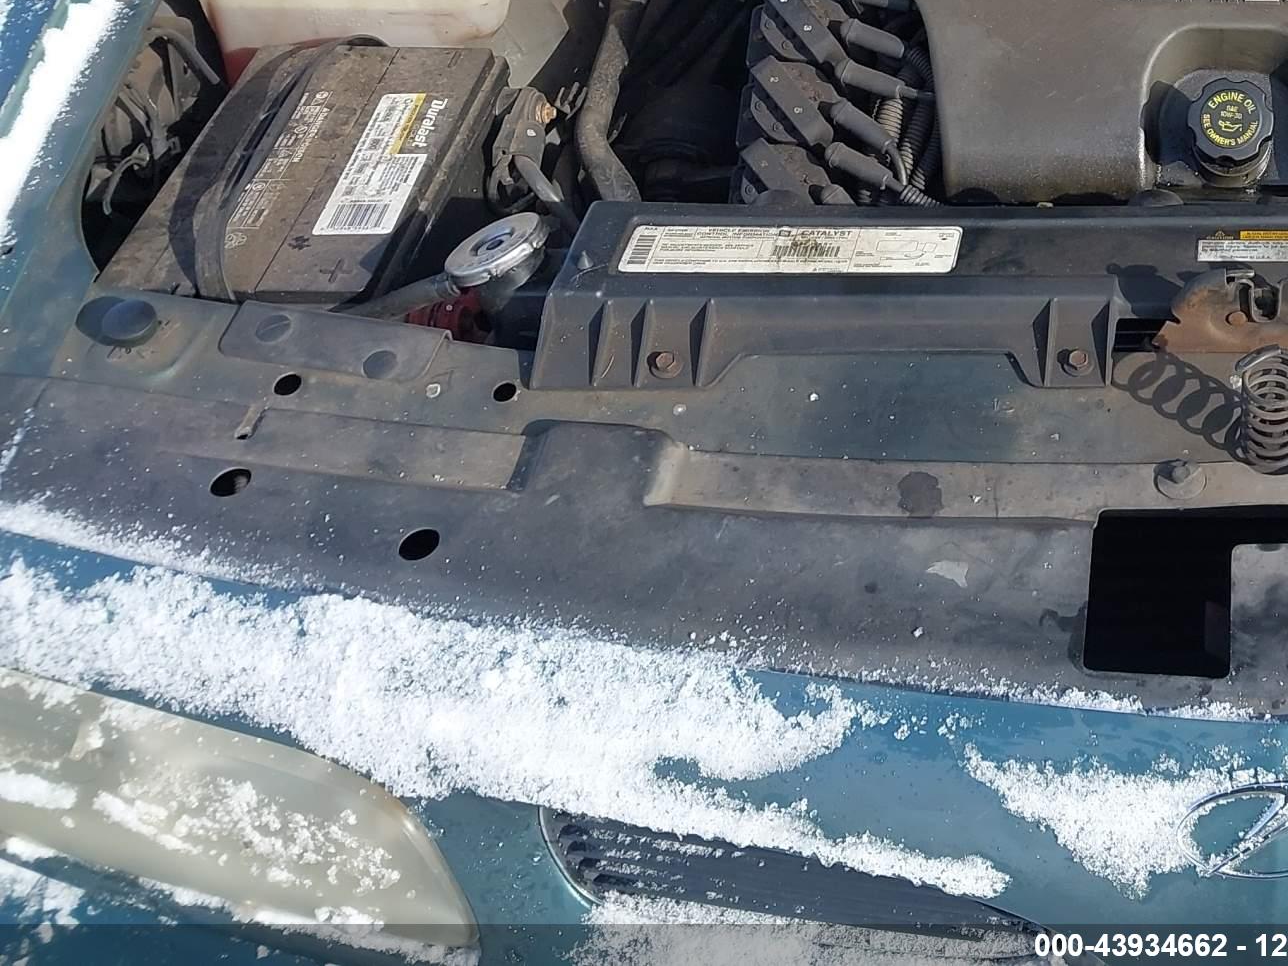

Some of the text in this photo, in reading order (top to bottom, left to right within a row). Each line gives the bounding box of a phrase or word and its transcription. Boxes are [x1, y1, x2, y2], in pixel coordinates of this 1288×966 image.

[1208, 91, 1257, 114] ENGINE OIL
[412, 98, 449, 148] Duralast
[1203, 113, 1259, 146] SEE OWNER'S MANUAL
[801, 230, 853, 239] CATALYST
